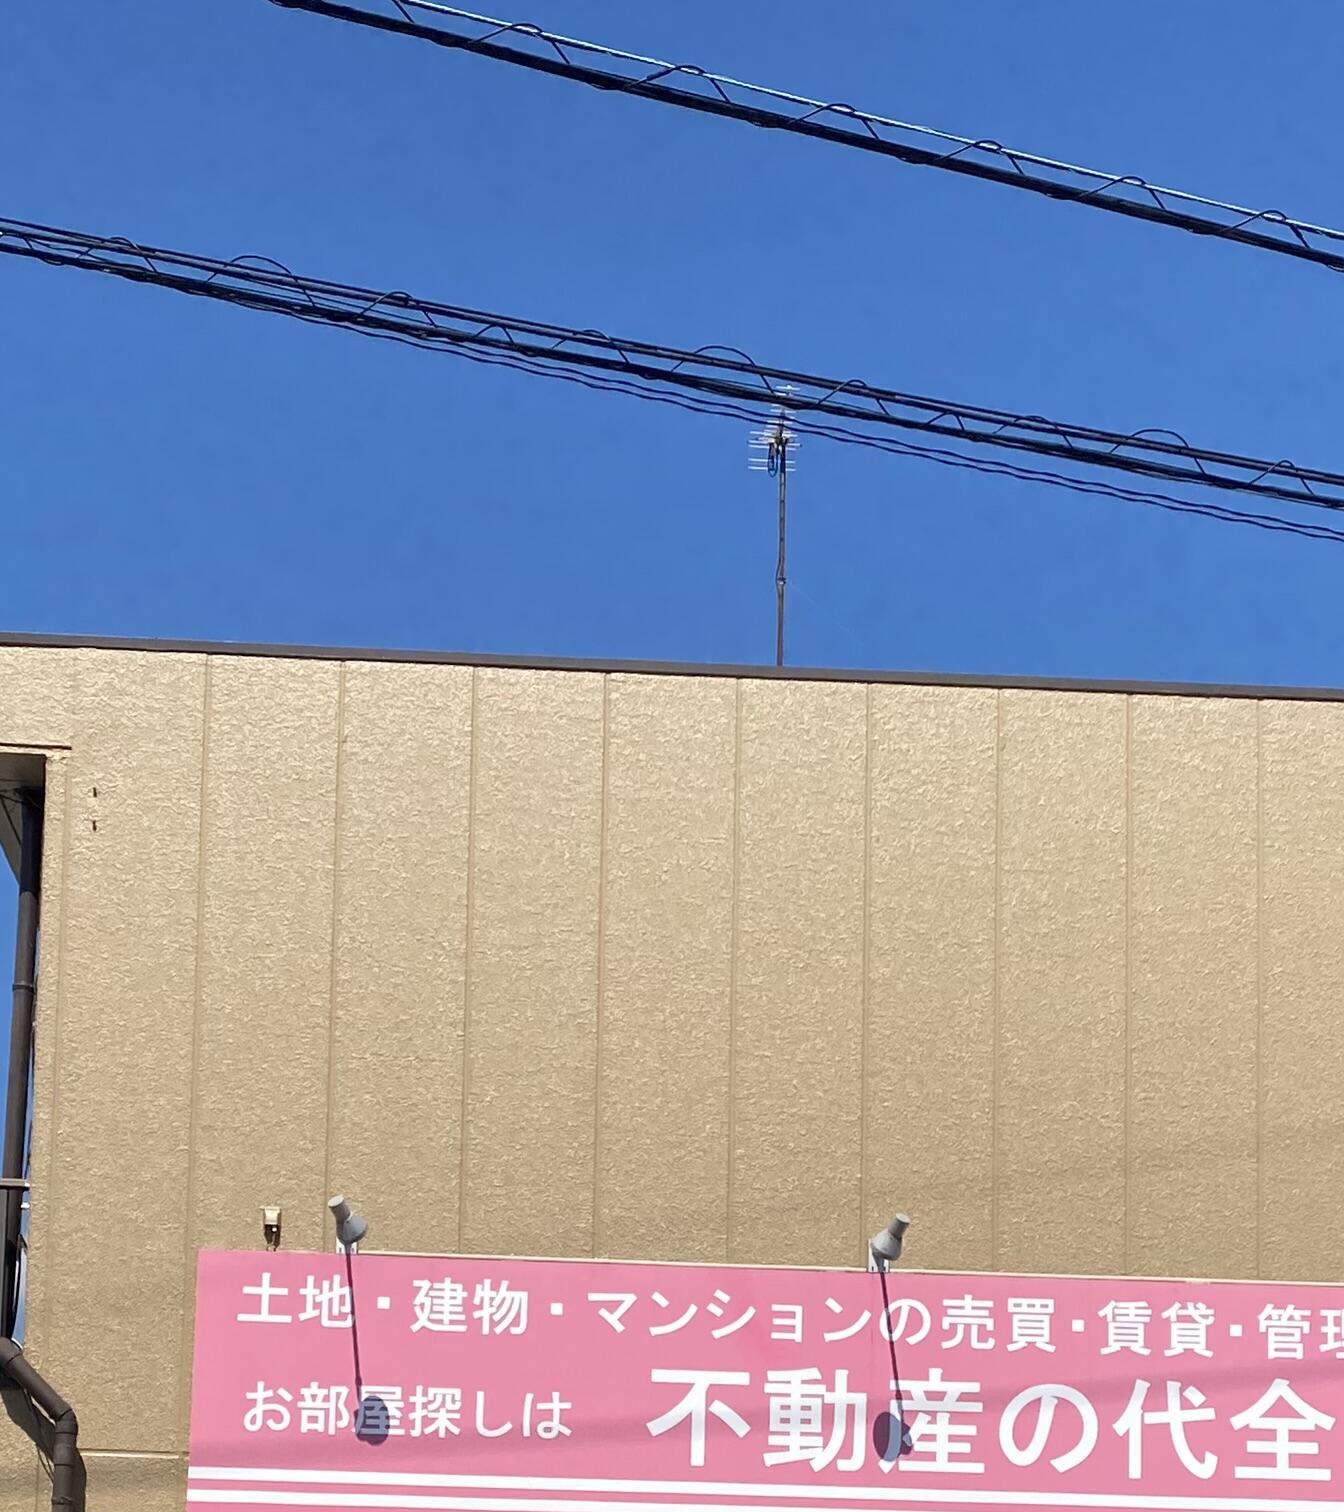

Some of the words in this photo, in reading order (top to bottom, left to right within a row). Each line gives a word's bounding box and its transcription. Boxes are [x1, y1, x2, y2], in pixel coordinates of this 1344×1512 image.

[242, 1379, 573, 1441] お部屋探しは
[646, 1366, 1337, 1482] 不動産の代全
